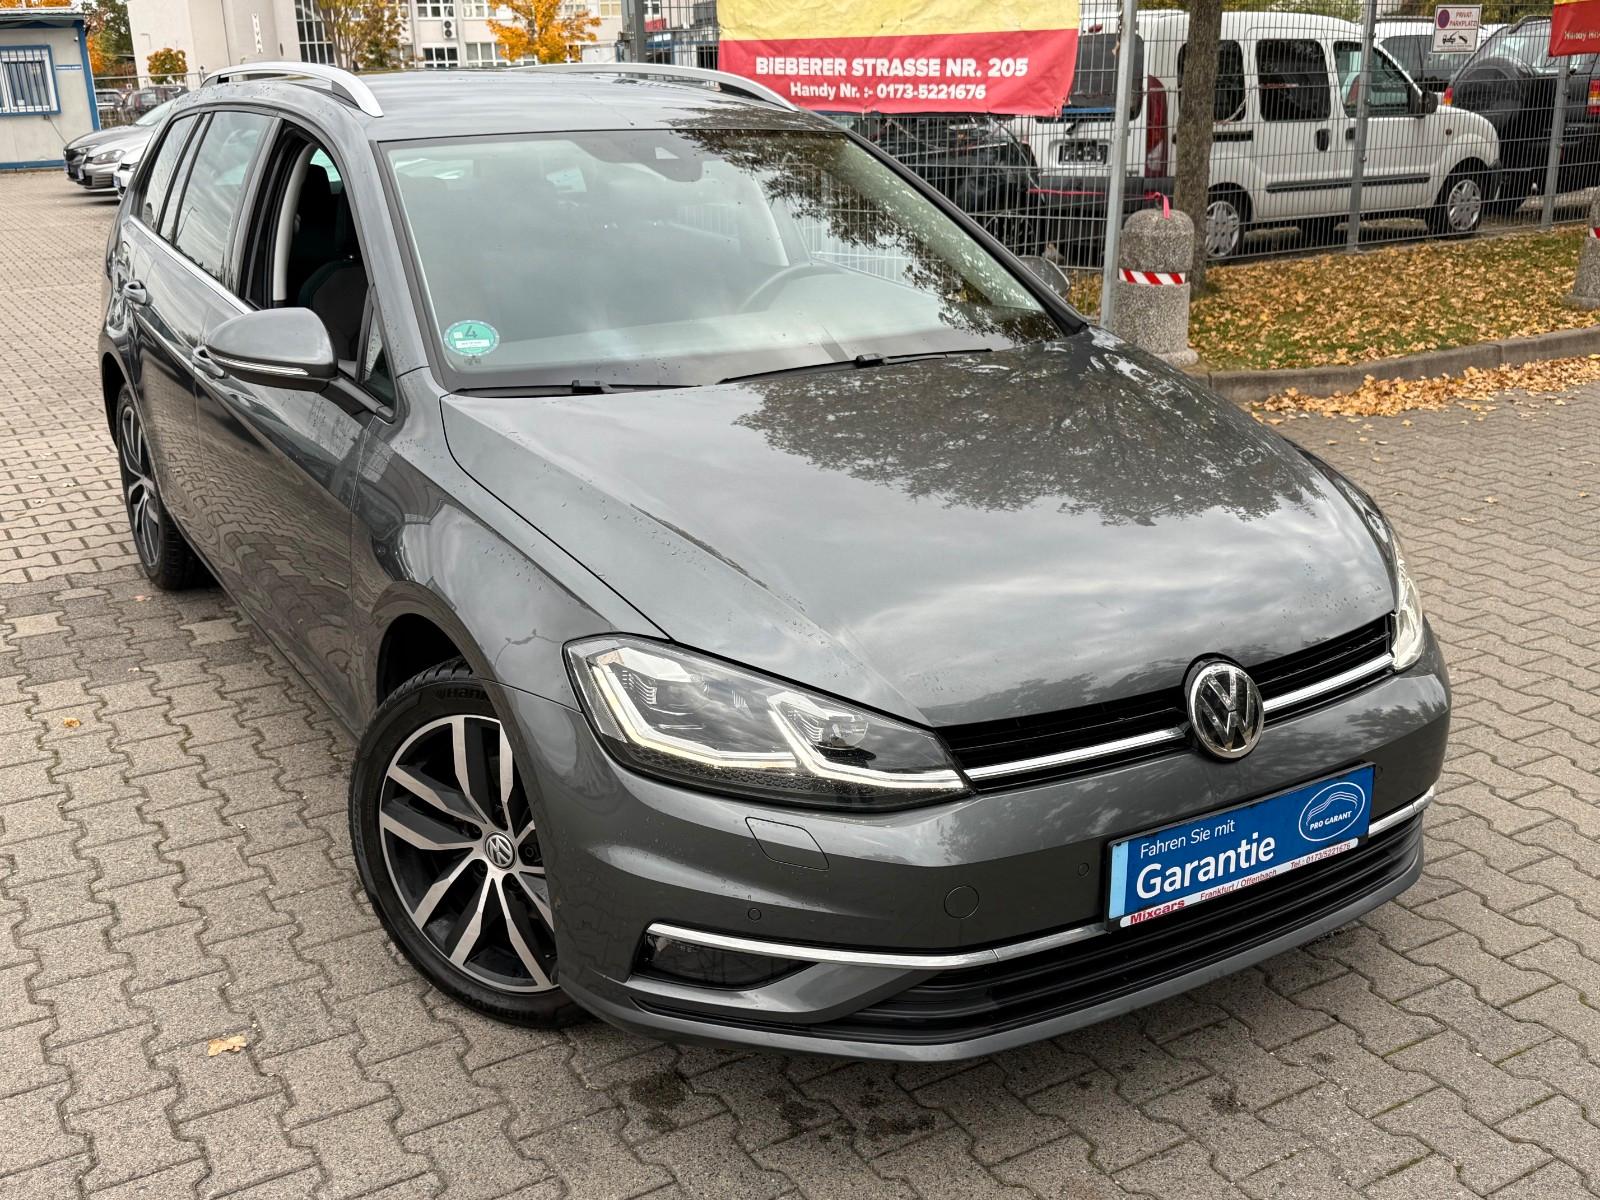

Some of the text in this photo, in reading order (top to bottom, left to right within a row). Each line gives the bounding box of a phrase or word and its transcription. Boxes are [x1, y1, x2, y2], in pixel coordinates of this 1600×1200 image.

[755, 56, 1028, 77] BIEBERER STRASSE NR. 205
[790, 82, 836, 99] Handy
[839, 83, 860, 98] Nr.
[877, 83, 987, 99] 0173-5221676
[464, 325, 478, 338] 4
[1309, 810, 1352, 831] PRO GARANT
[1140, 819, 1236, 859] Fahren Sie mit
[1135, 832, 1276, 900] Garantie
[1129, 899, 1186, 926] Mixcars
[1200, 882, 1236, 901] Frankfurt
[1240, 868, 1277, 888] Offenbach
